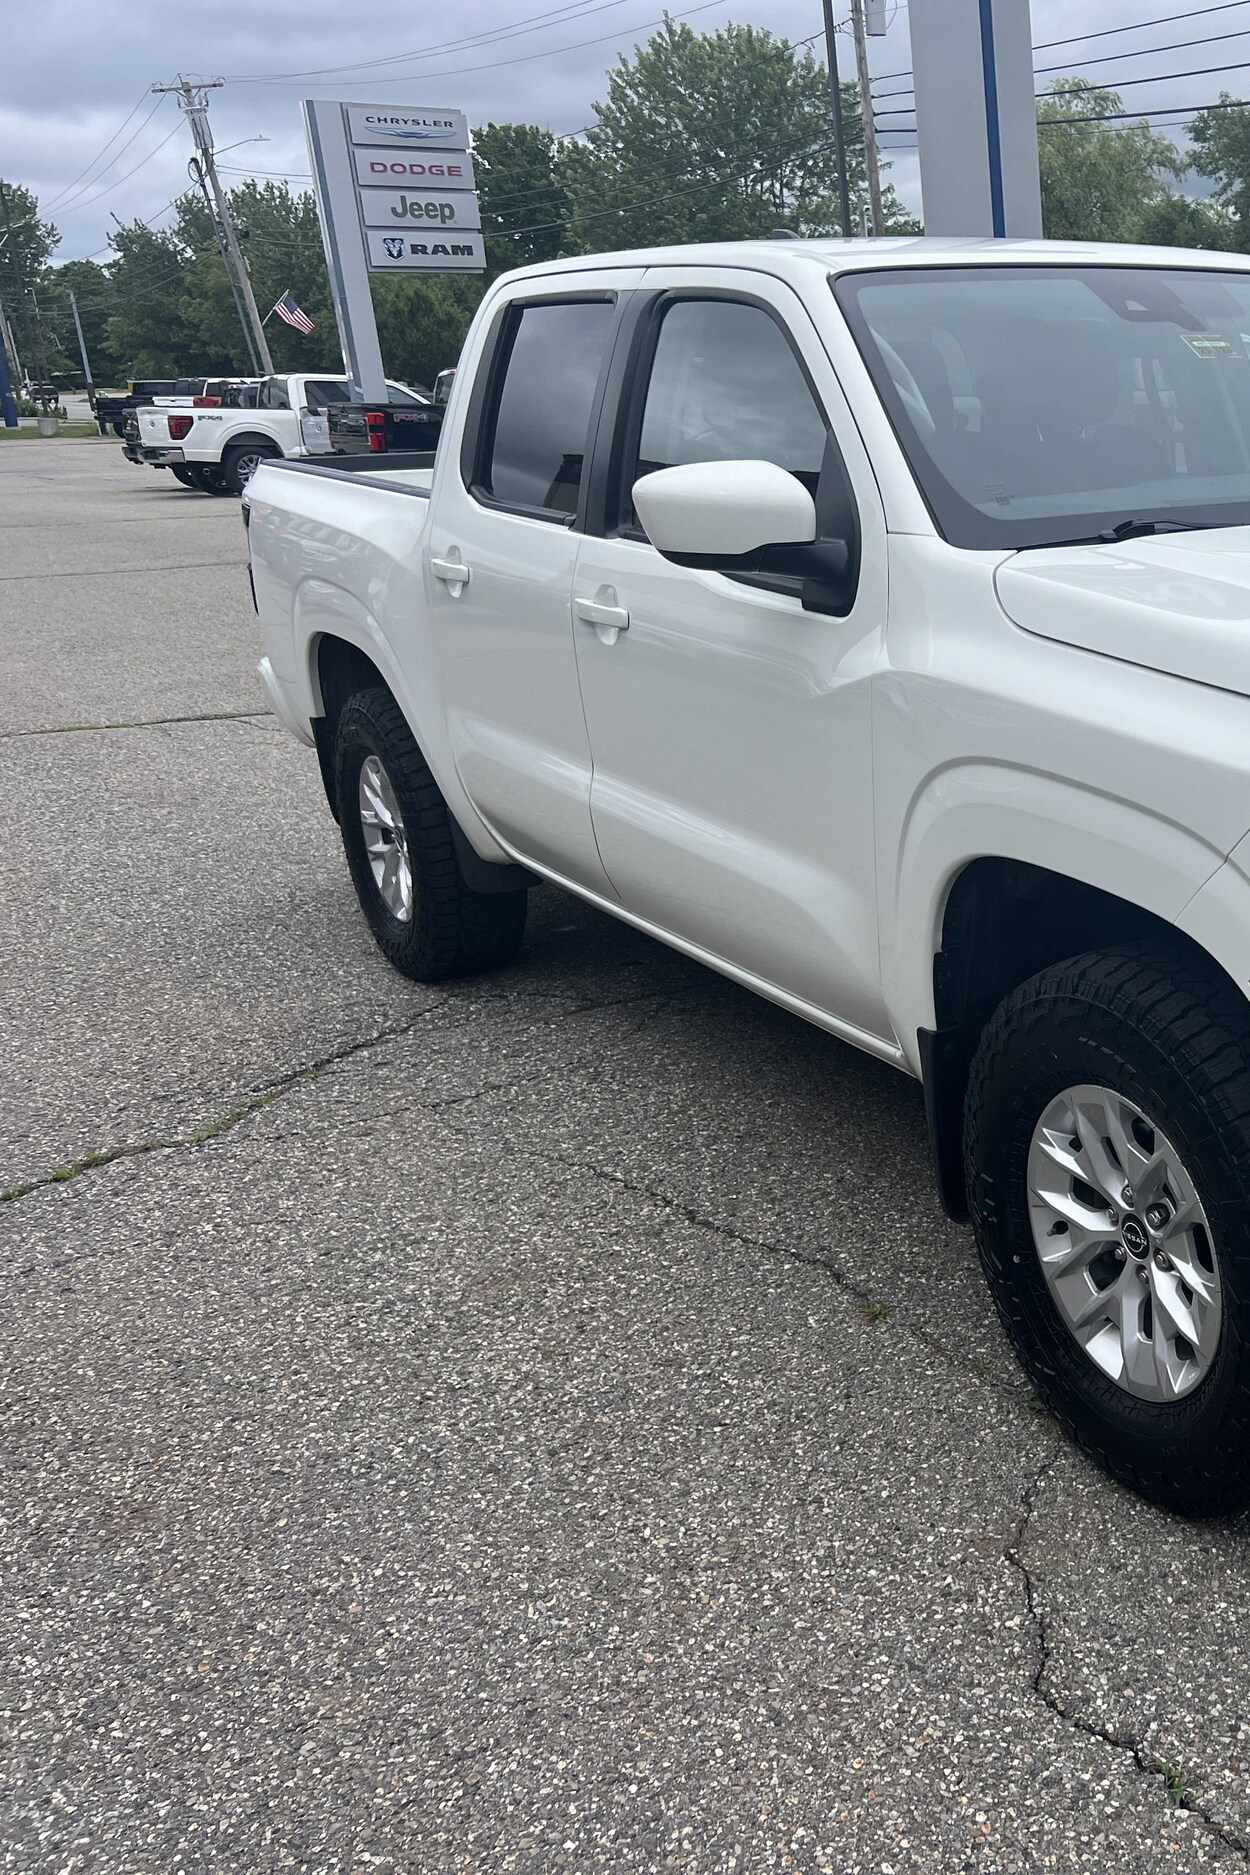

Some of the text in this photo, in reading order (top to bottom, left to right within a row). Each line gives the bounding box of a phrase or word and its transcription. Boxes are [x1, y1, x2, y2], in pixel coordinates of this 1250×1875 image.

[366, 116, 454, 128] CHRYSLER
[370, 161, 463, 177] DODGE
[390, 195, 455, 225] Jeep
[410, 243, 474, 256] RAM
[393, 413, 429, 423] FX4
